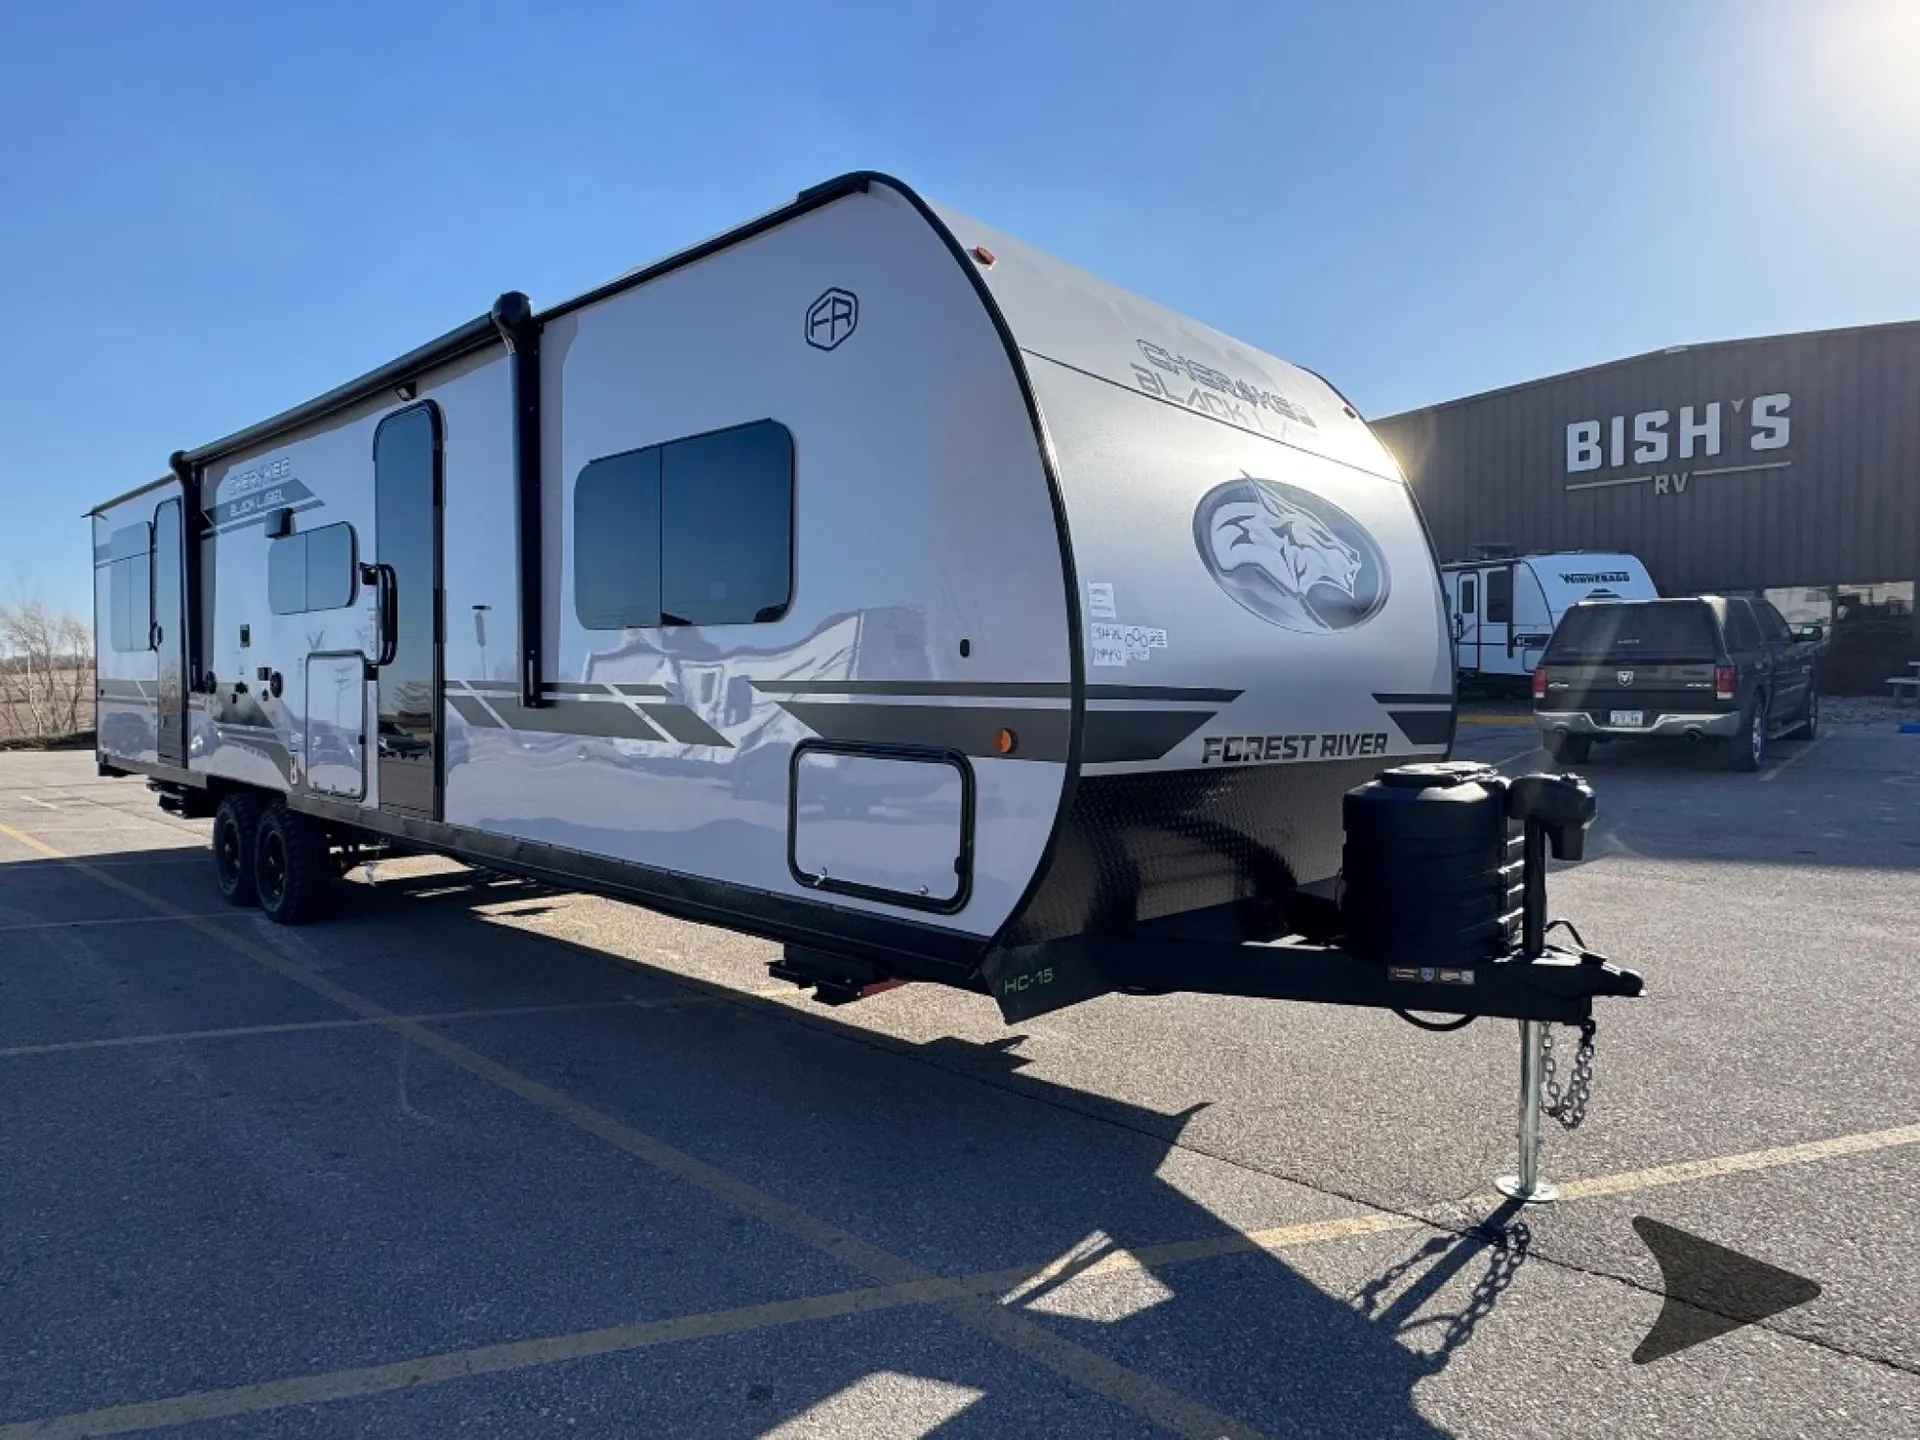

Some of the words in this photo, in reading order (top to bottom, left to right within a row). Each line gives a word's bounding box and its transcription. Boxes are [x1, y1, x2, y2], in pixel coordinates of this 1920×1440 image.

[1130, 362, 1251, 427] BLACK
[1567, 393, 1791, 473] BISH'S
[1654, 472, 1688, 495] RV
[1202, 735, 1317, 763] FOREST
[1320, 733, 1388, 757] RIVER
